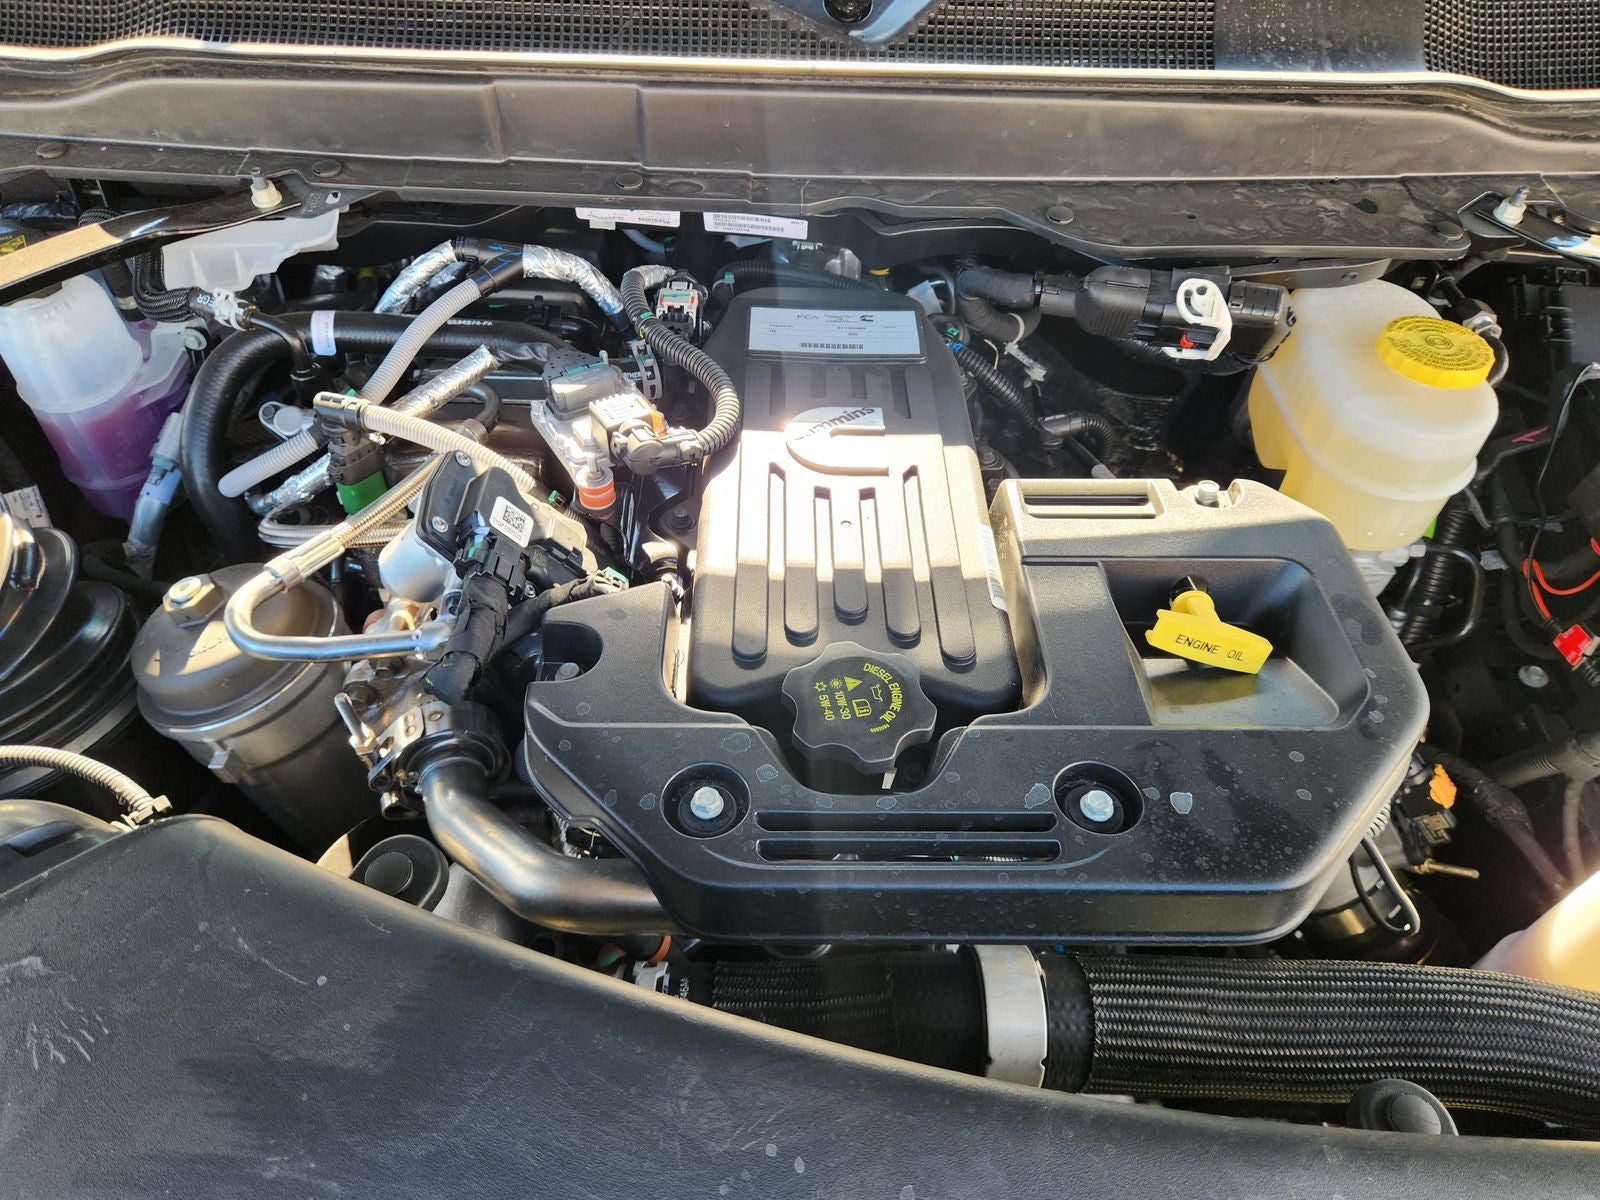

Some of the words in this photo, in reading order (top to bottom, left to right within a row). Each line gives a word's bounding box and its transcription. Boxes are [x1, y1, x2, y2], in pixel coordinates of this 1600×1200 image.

[794, 406, 876, 441] ummins
[1175, 633, 1222, 655] ENGINE
[1227, 649, 1245, 662] OIL
[863, 663, 894, 685] DIESEL
[818, 694, 836, 721] 5W-40
[834, 690, 852, 720] 10W-30
[889, 682, 904, 713] ENGINE
[879, 710, 897, 723] OIL
